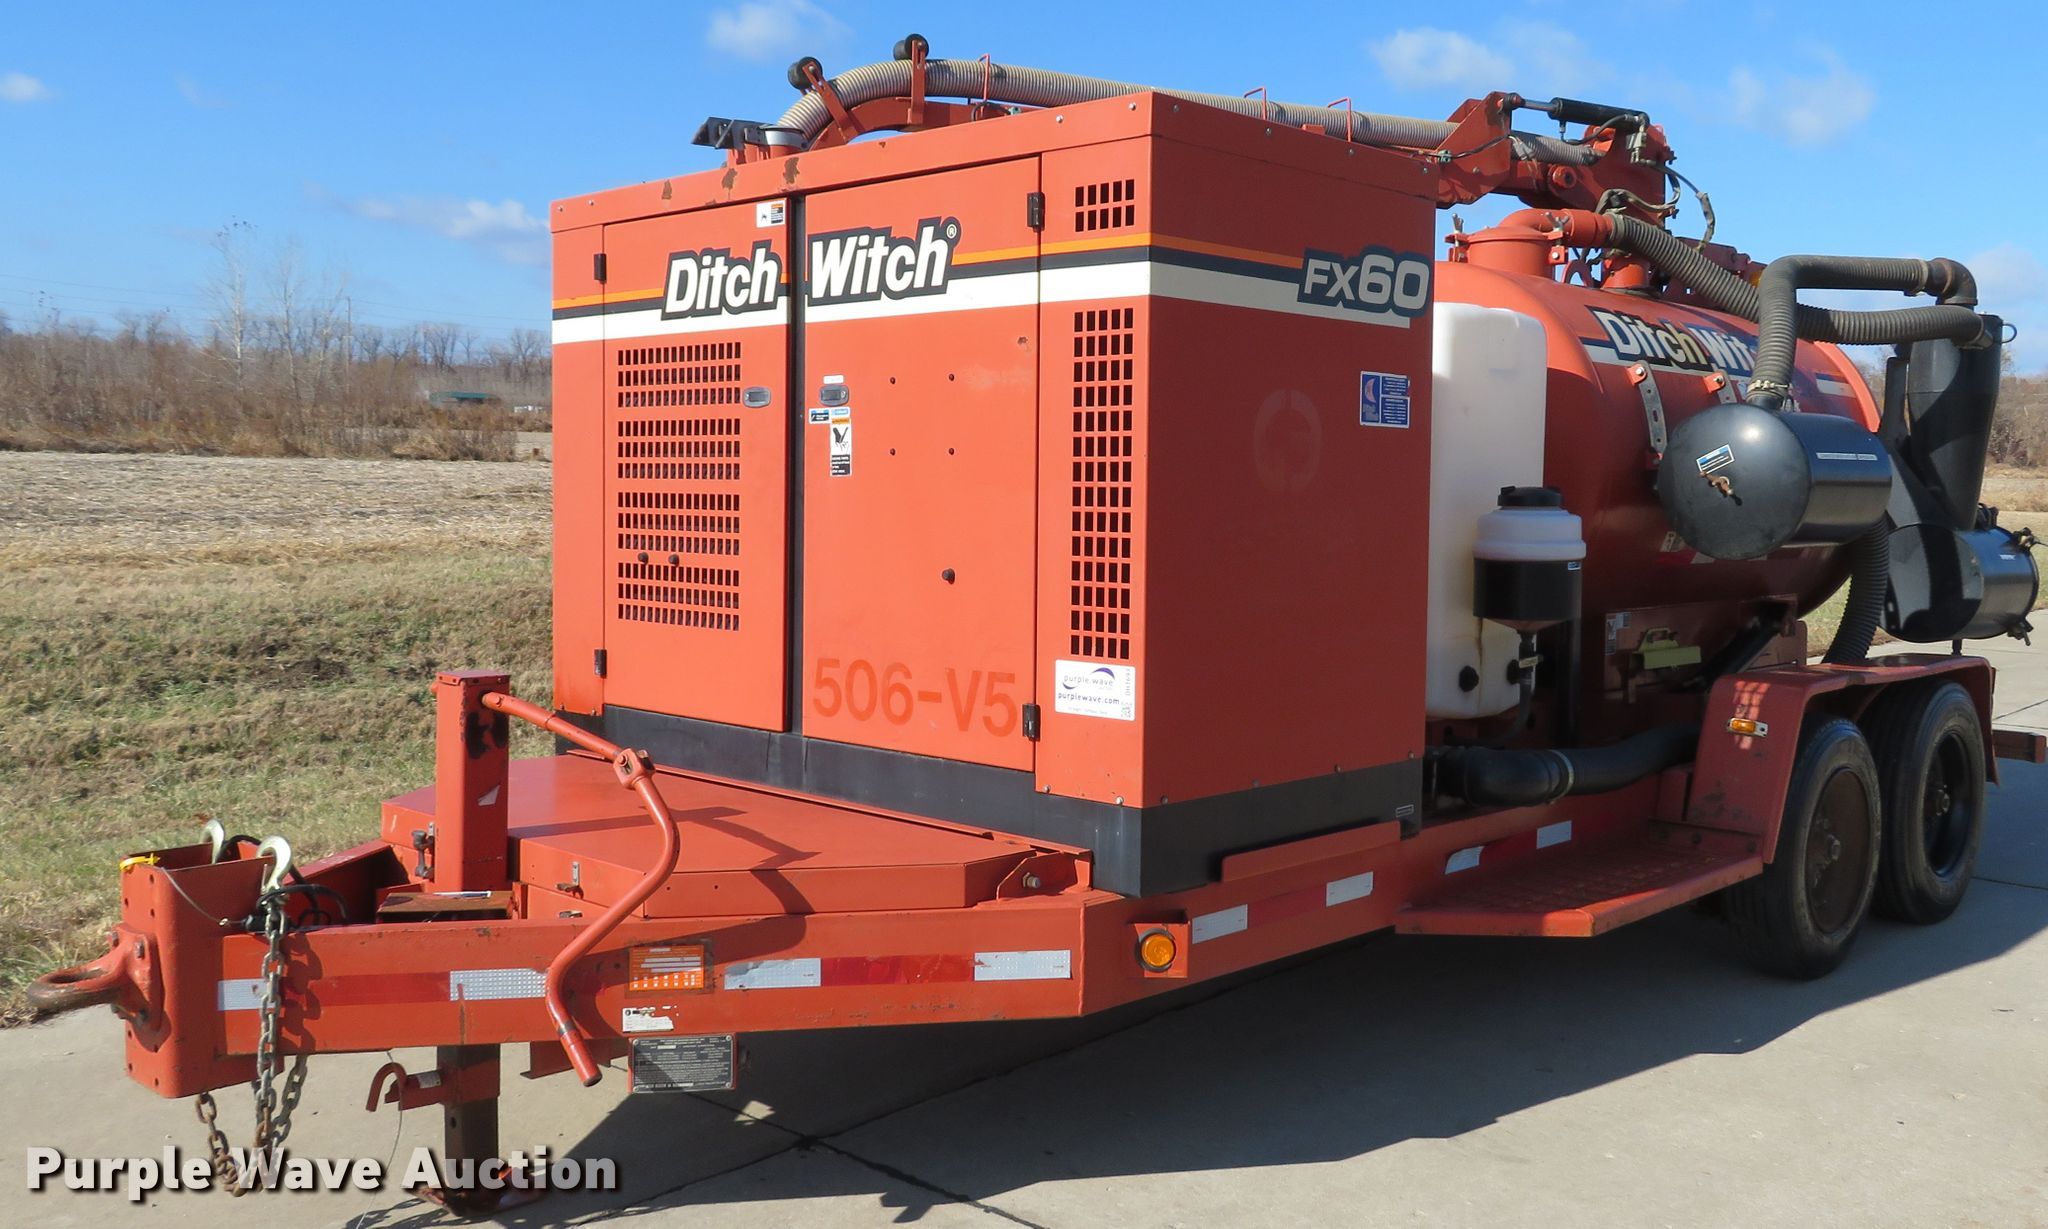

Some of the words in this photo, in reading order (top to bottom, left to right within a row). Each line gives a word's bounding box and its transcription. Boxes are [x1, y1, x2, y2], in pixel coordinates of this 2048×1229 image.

[665, 247, 779, 313] Ditch
[1304, 254, 1430, 310] FX60
[1593, 310, 1708, 365] Ditch
[1687, 327, 1757, 371] Wit
[813, 657, 1018, 737] 506-V5
[1058, 692, 1120, 705] purplewave.com
